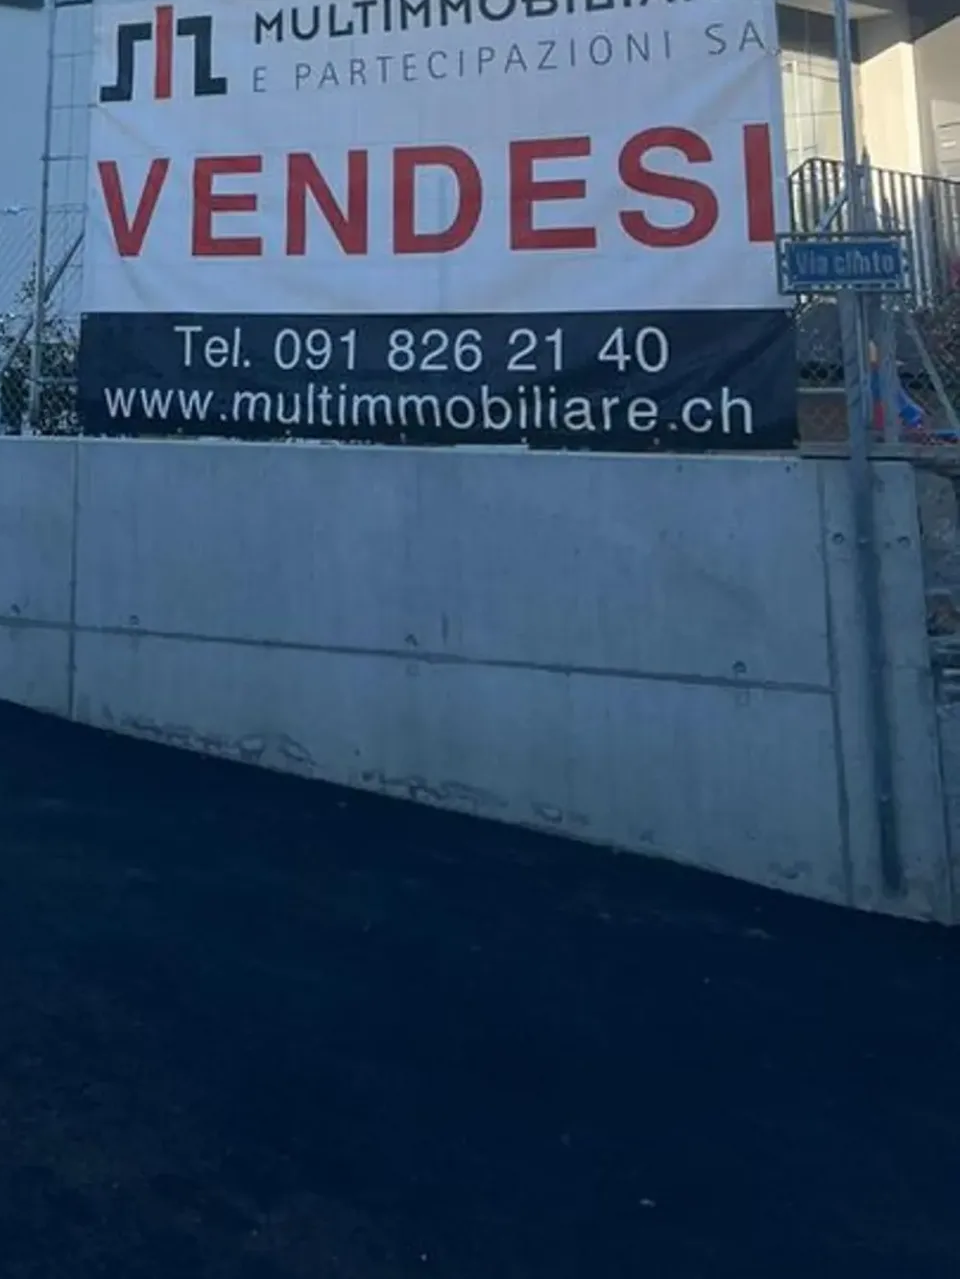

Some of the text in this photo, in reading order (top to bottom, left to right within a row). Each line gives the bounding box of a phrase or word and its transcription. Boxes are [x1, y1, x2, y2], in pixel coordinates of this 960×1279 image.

[252, 19, 765, 94] E PARTECIPAZIONI SA
[97, 122, 776, 258] VENDESI
[795, 249, 828, 276] Via
[173, 325, 670, 372] Tel. 091 826 21 40
[104, 383, 754, 434] www.multimmobiliare.ch
